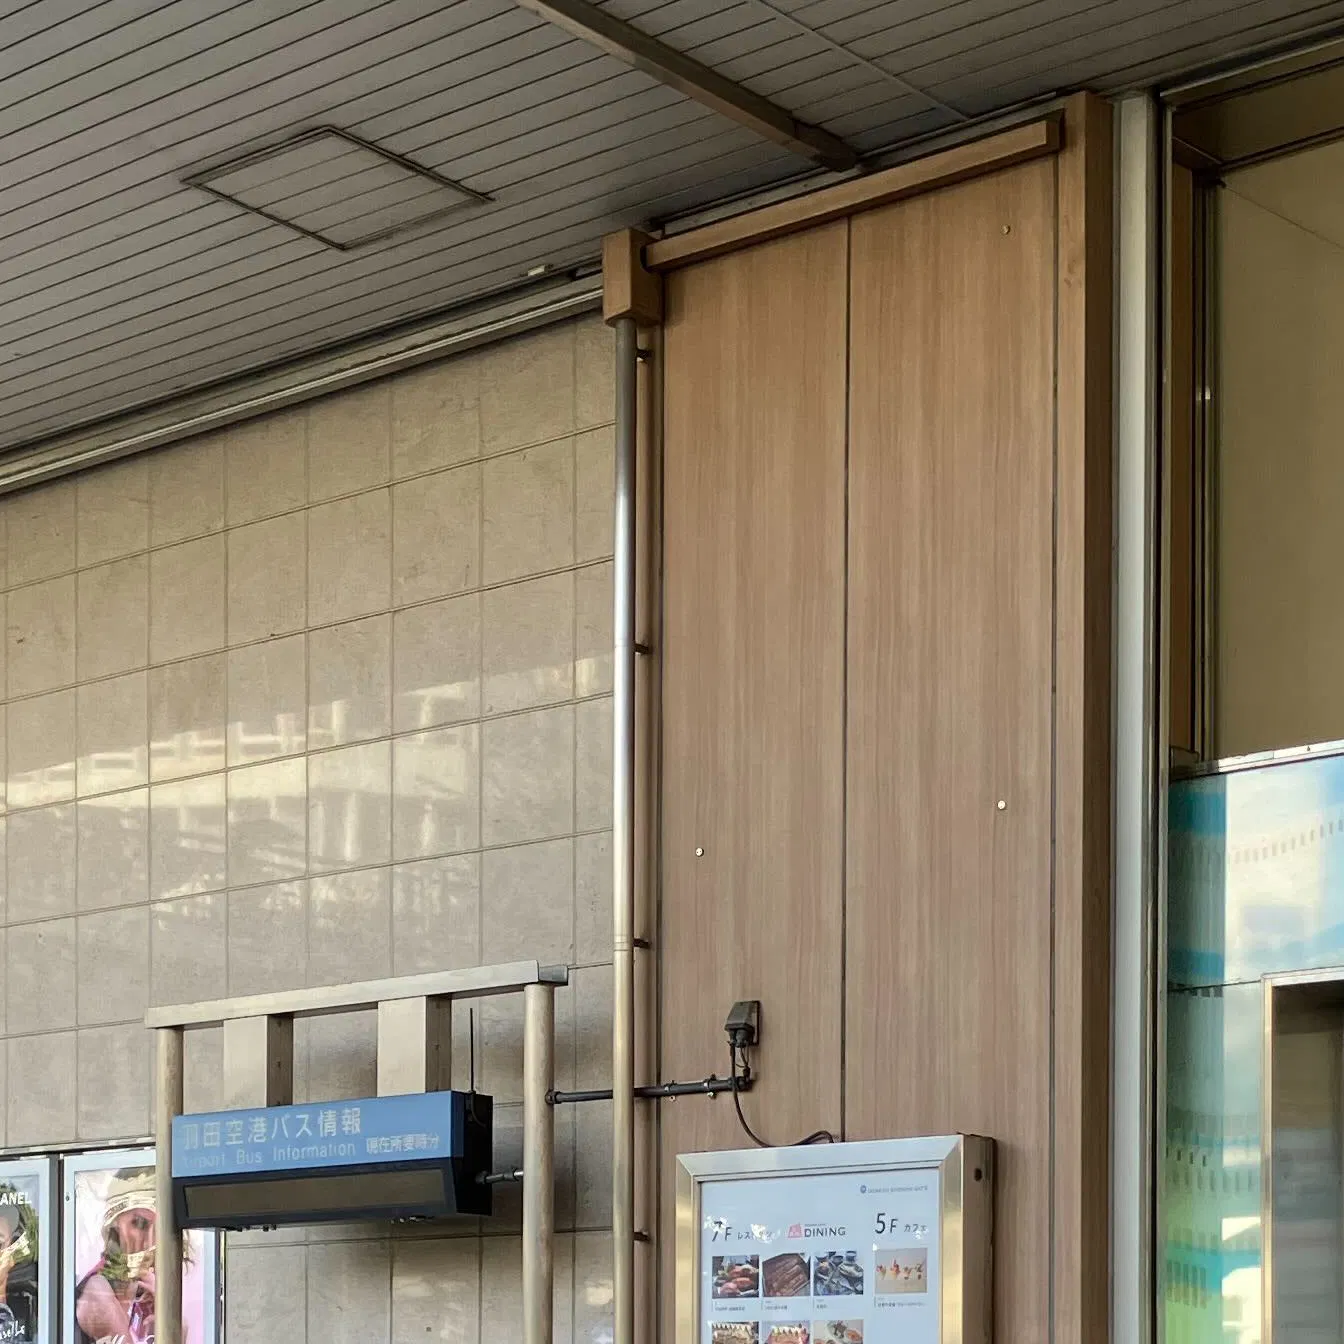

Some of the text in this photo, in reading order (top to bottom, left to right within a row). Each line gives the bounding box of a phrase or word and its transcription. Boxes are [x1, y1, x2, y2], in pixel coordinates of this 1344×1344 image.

[182, 1107, 361, 1150] 羽田空港バス情報
[236, 1151, 263, 1166] Bus
[273, 1142, 356, 1162] Information
[804, 1227, 846, 1238] DINING
[875, 1213, 927, 1234] 5F カフェ
